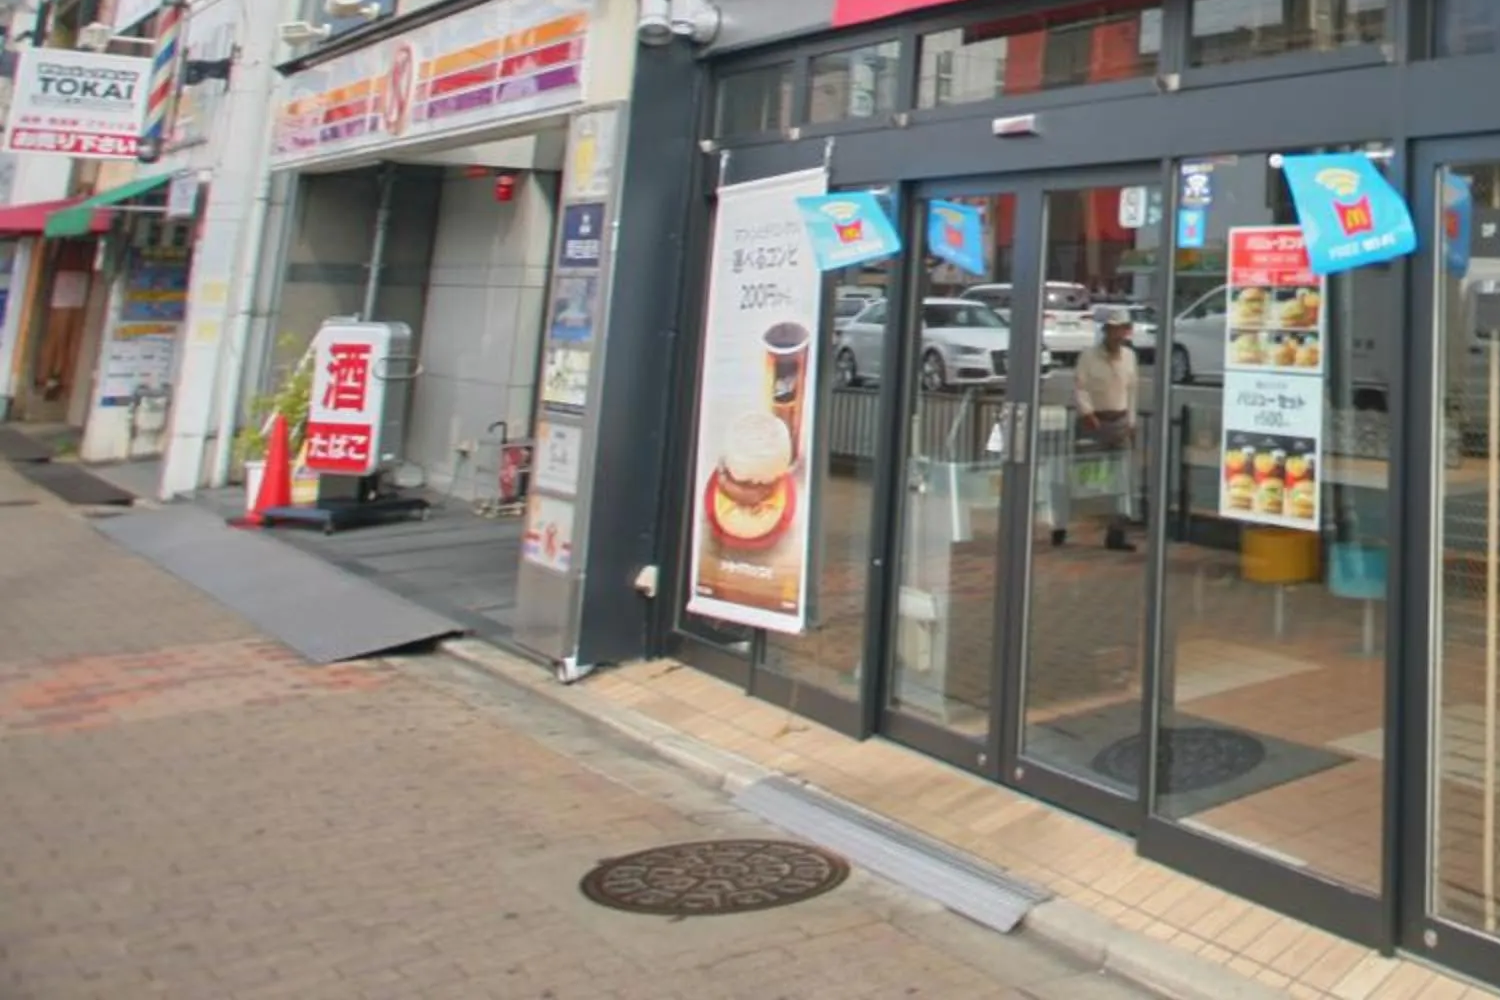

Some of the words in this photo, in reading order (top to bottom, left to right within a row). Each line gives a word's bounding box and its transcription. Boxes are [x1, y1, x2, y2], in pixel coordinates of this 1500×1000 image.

[38, 76, 135, 100] TOKAI
[322, 343, 372, 412] 酒
[308, 432, 368, 461] たばこ
